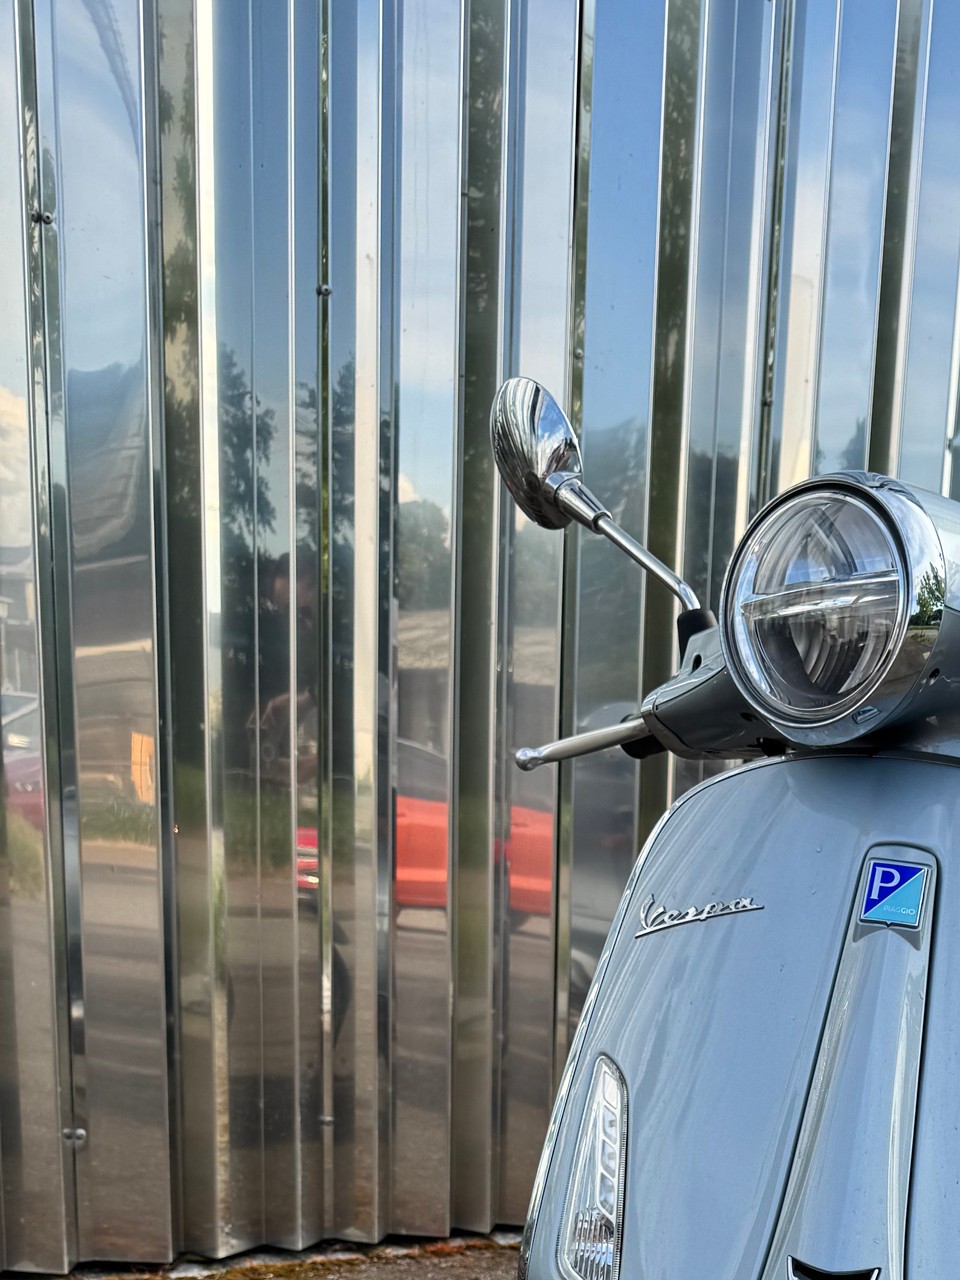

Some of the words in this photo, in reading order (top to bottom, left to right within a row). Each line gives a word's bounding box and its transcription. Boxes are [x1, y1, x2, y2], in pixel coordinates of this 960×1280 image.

[870, 866, 901, 900] P
[635, 893, 764, 939] Vespa
[883, 904, 916, 916] PIAGGIO
